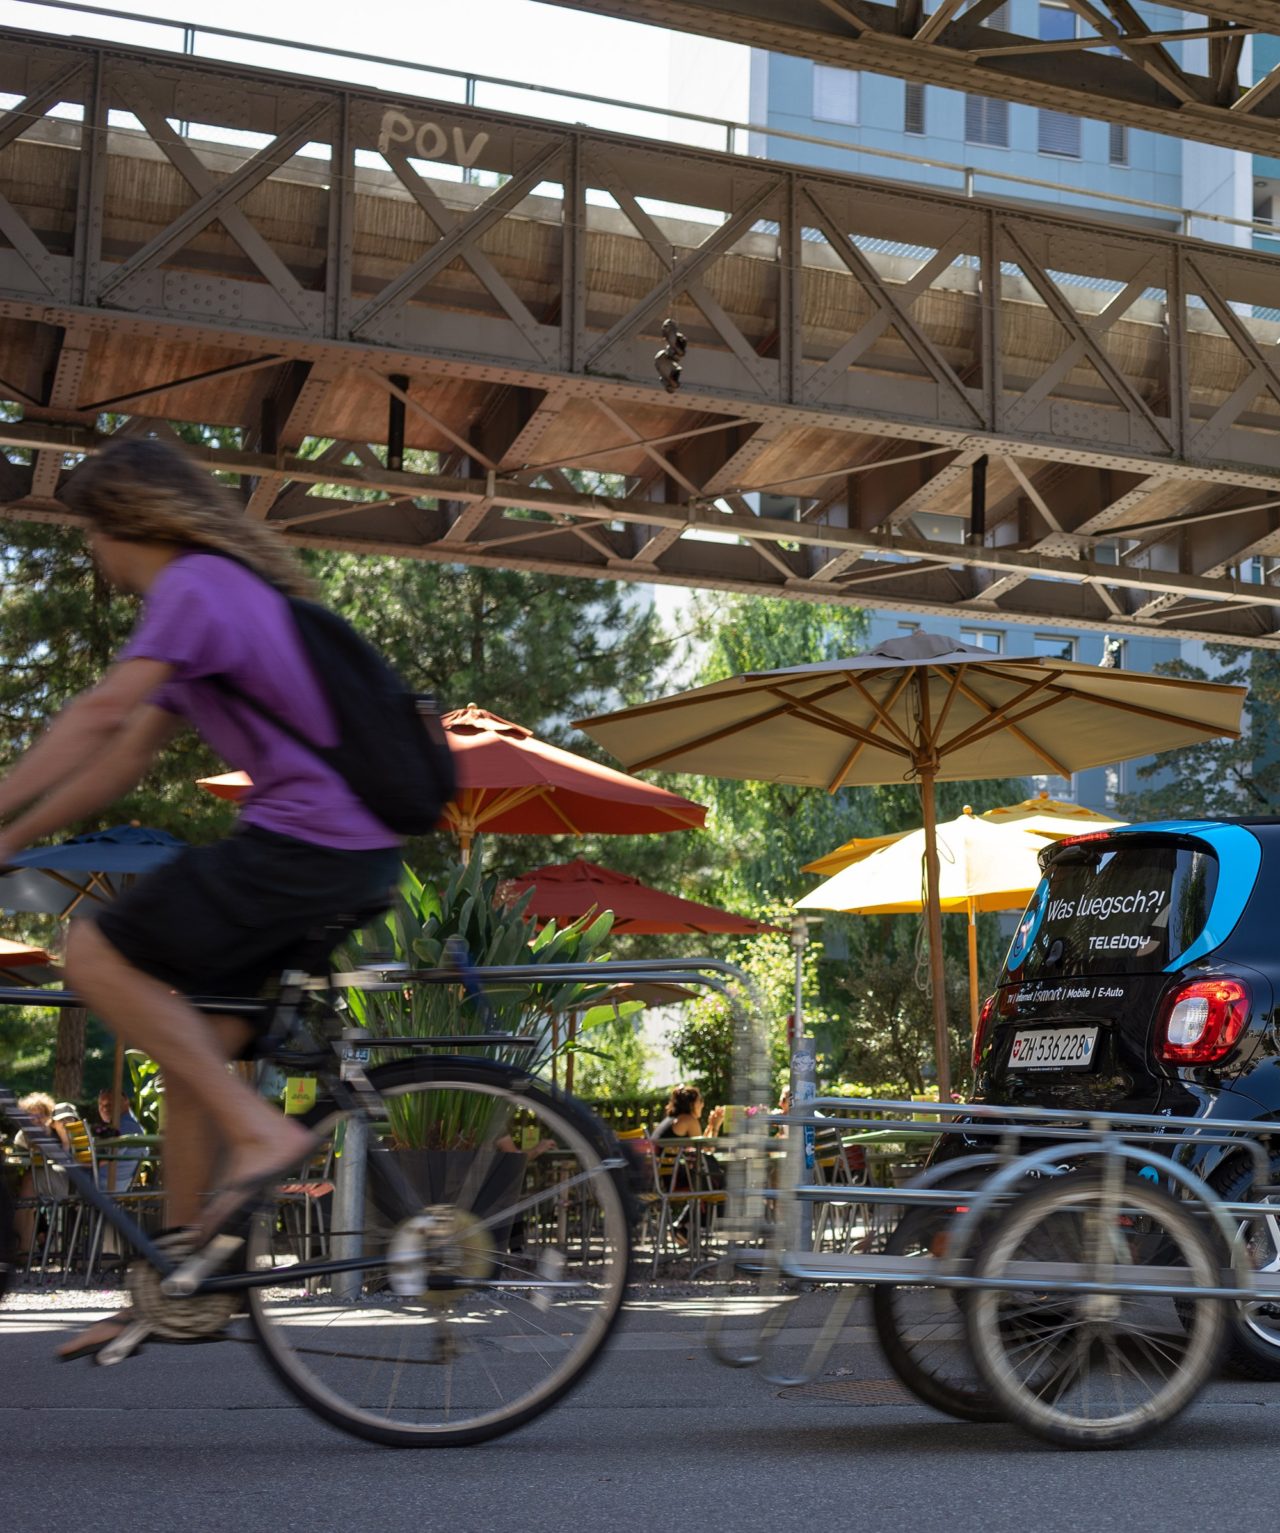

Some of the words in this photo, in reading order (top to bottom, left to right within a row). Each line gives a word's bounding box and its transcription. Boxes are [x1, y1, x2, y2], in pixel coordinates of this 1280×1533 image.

[378, 110, 489, 167] POV
[1047, 899, 1075, 922] Was
[1076, 889, 1165, 920] luegsch?!
[1067, 987, 1090, 998] Mobile
[1098, 987, 1124, 997] E-Auto
